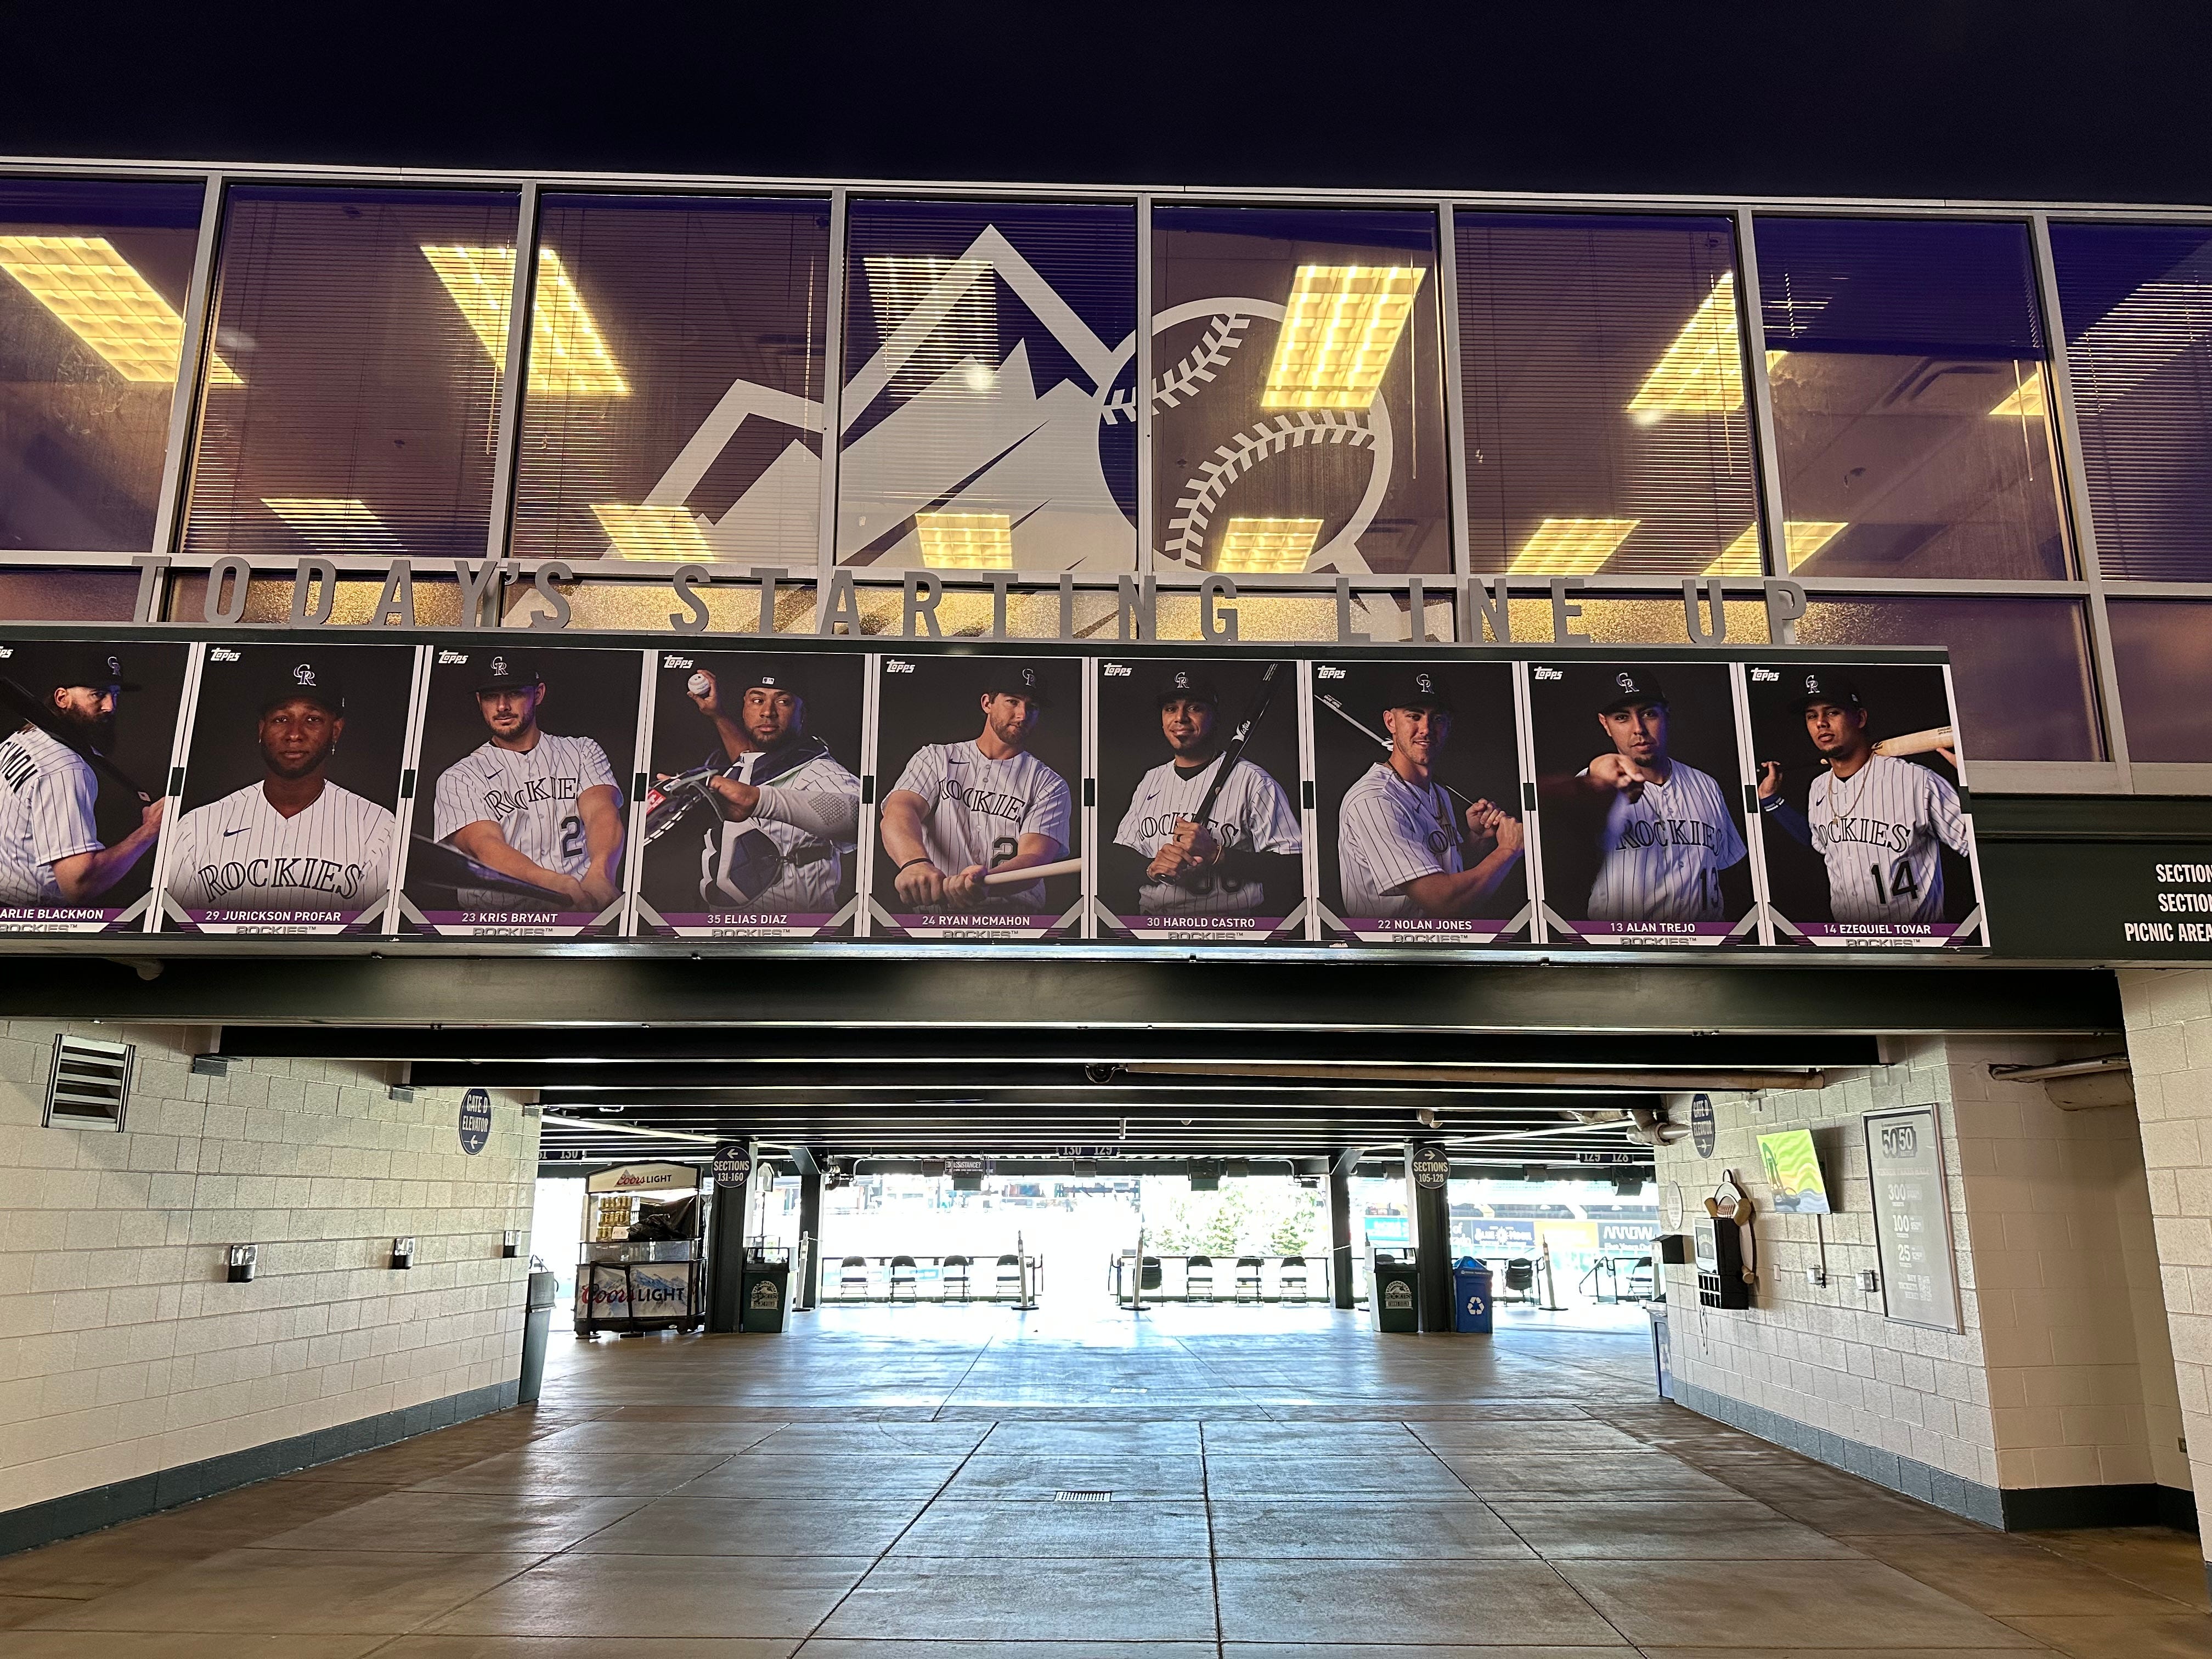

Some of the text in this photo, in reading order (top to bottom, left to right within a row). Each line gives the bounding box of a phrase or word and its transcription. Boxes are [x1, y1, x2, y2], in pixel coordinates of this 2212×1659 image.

[131, 556, 1807, 646] TODAY'S STARTING LINE UP
[198, 857, 363, 903] ROCKIES
[1871, 860, 1918, 904] 14
[37, 909, 104, 920] BLACKMON
[205, 911, 341, 922] 29 JURICKSON PROFAR
[461, 913, 558, 923] 23 KRIS BRYANT
[707, 915, 787, 924] 35 ELIAS DIAZ
[922, 916, 1030, 926] 24 RYAN MCMAHON
[1147, 917, 1256, 928] 30 HAROLD CASTRO
[1377, 920, 1472, 930] 22 NOLAN JONES
[1610, 922, 1696, 933] 13 ALAN TREJO
[1823, 924, 1931, 934] 14 EZEQUIEL TOVAR
[2124, 923, 2174, 941] PICNIC
[467, 1094, 488, 1114] GATE D
[462, 1115, 489, 1132] ELEVATOR
[560, 1150, 578, 1159] 130
[1063, 1147, 1082, 1155] 130
[713, 1160, 749, 1171] SECTIONS
[1413, 1161, 1448, 1172] SECTIONS
[616, 1174, 672, 1186] Coors LIGHT
[717, 1172, 743, 1181] 131-160
[1419, 1173, 1444, 1182] 105-128
[1888, 1184, 1906, 1200] 300
[1893, 1215, 1909, 1232] 100
[1898, 1244, 1911, 1261] 25
[638, 1287, 685, 1302] LIGHT
